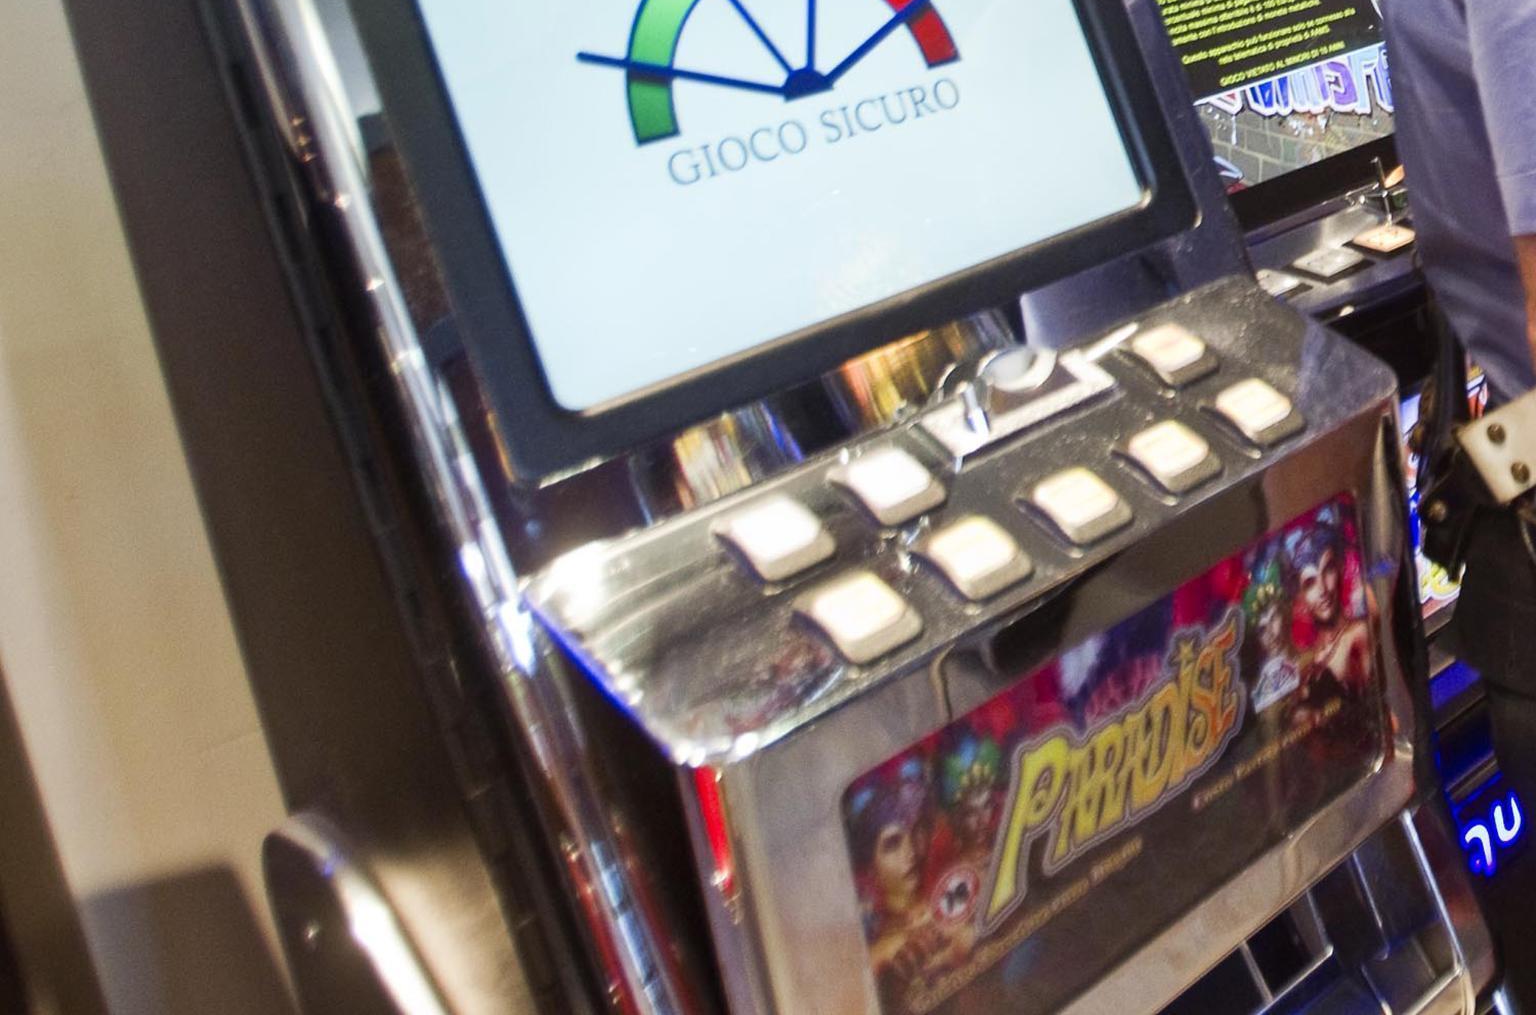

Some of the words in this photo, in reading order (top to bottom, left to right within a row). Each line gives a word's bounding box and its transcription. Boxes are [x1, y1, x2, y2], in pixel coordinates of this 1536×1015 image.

[666, 119, 809, 186] GIOCO
[818, 77, 962, 144] SICURO
[979, 614, 1244, 926] PARADISE
